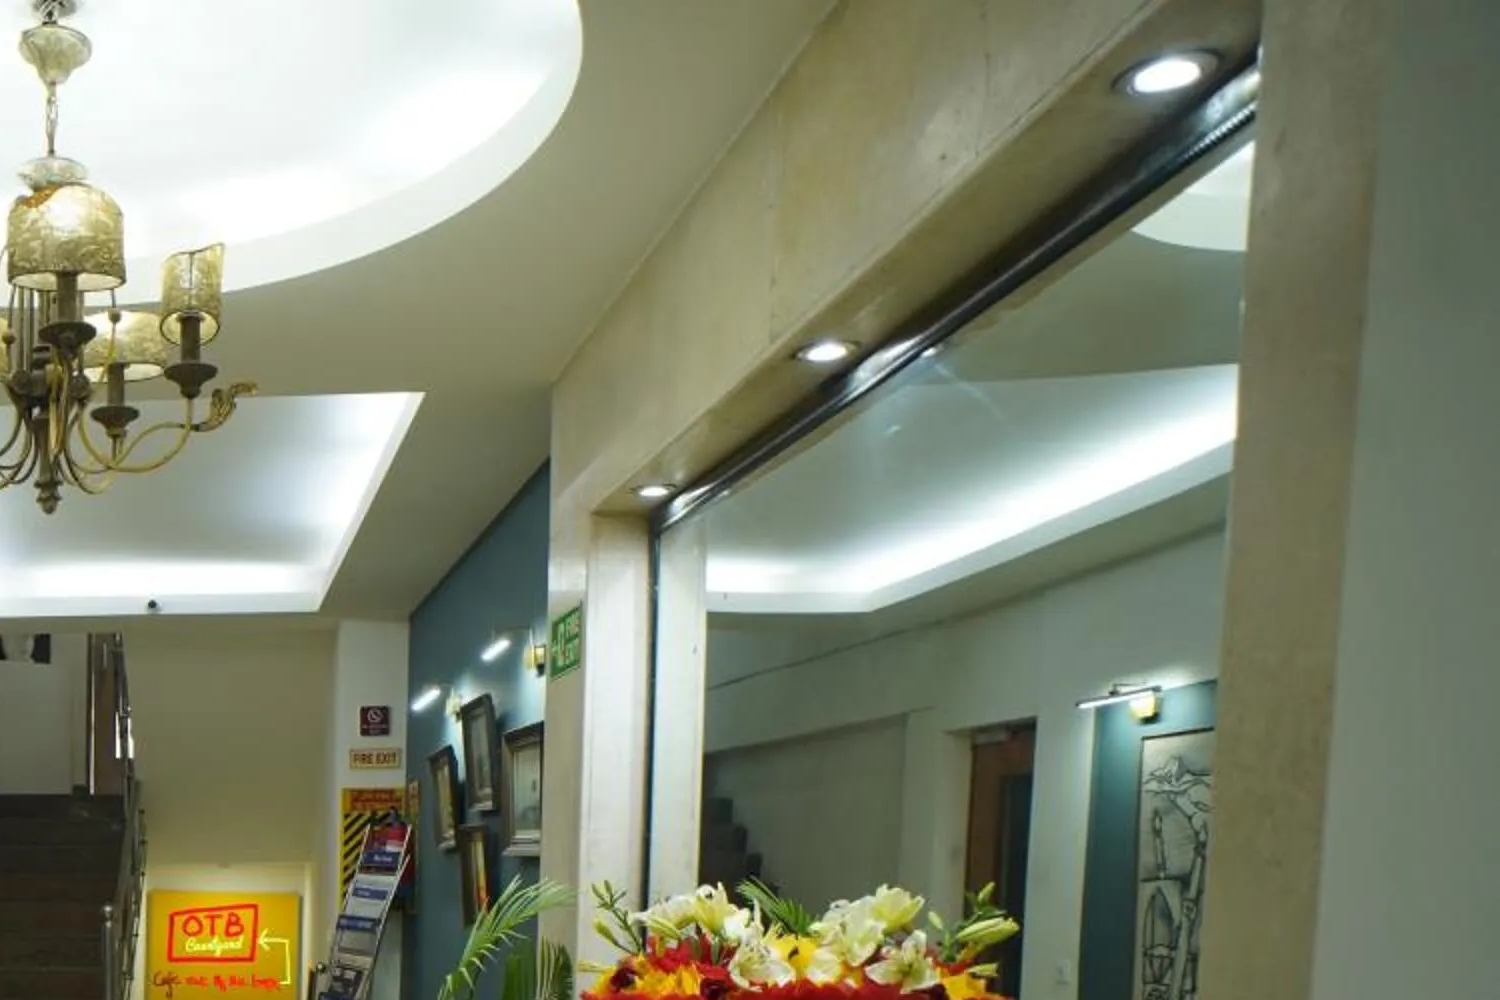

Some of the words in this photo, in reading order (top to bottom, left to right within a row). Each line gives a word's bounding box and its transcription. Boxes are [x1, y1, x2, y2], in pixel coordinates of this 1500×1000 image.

[353, 752, 373, 765] FIRE
[376, 751, 397, 764] EXIT
[182, 911, 245, 937] OTB
